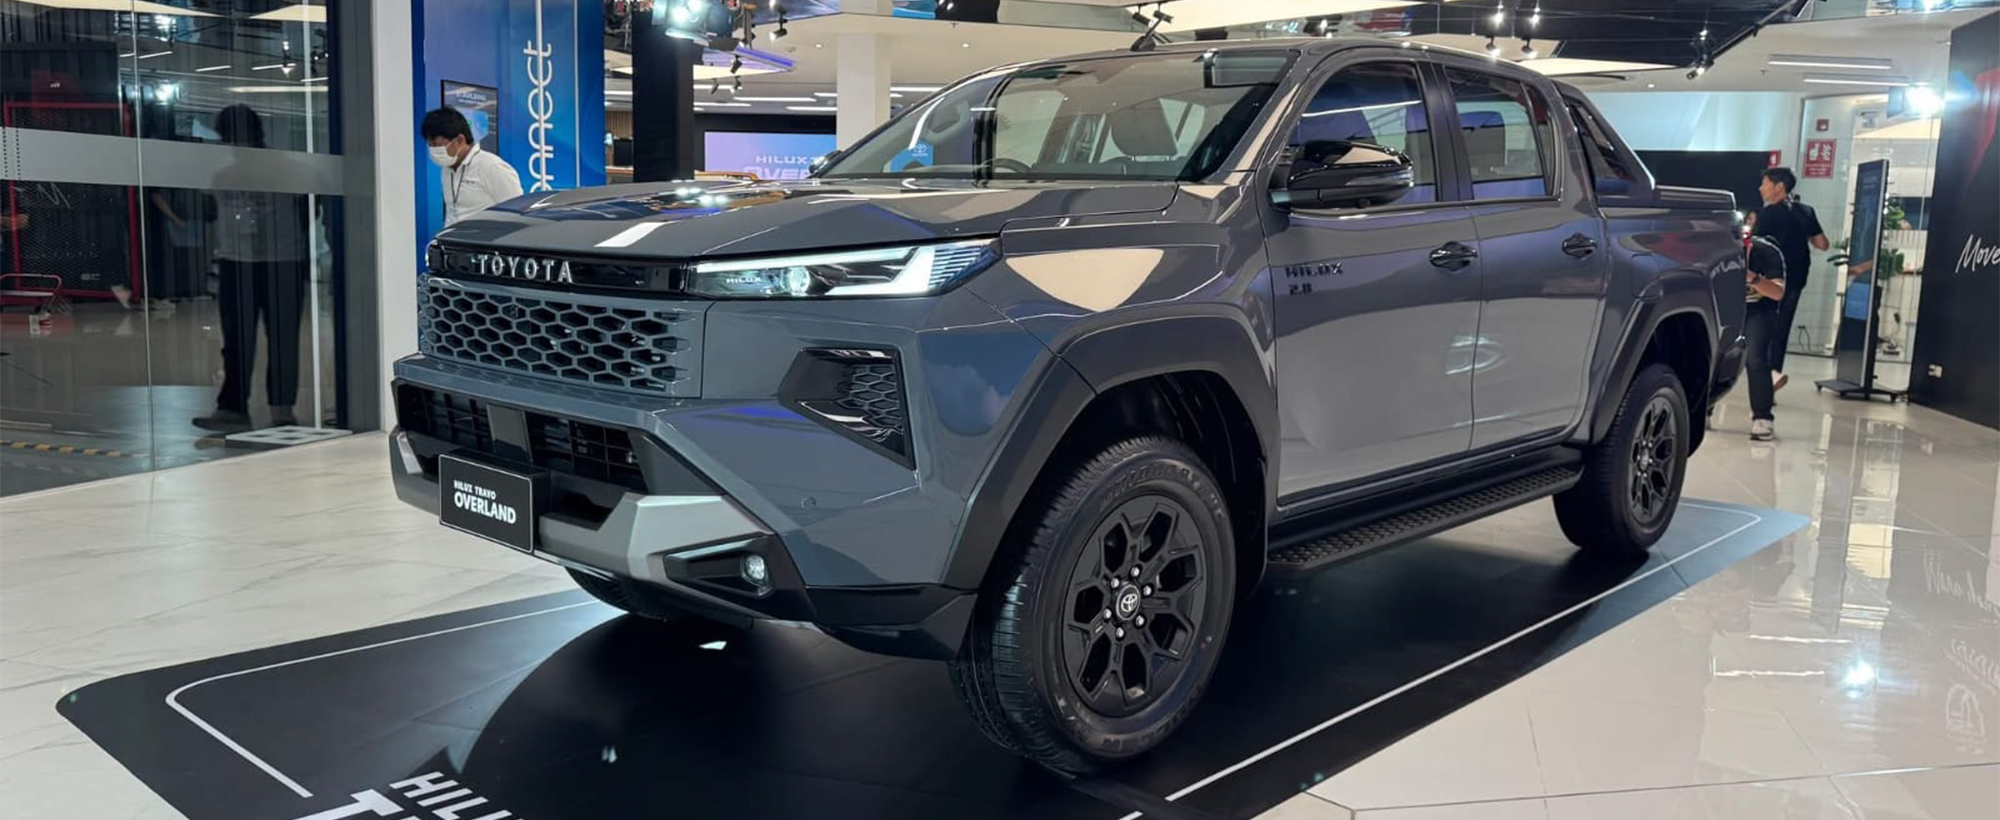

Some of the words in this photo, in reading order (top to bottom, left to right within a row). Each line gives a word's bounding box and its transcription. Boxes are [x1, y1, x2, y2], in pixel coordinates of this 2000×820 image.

[755, 155, 808, 164] HILUX
[1955, 234, 2000, 273] Move
[478, 254, 572, 283] TOYOTA
[454, 480, 473, 493] HILUX
[475, 486, 496, 500] TRAVO
[454, 491, 517, 524] OVERLAND
